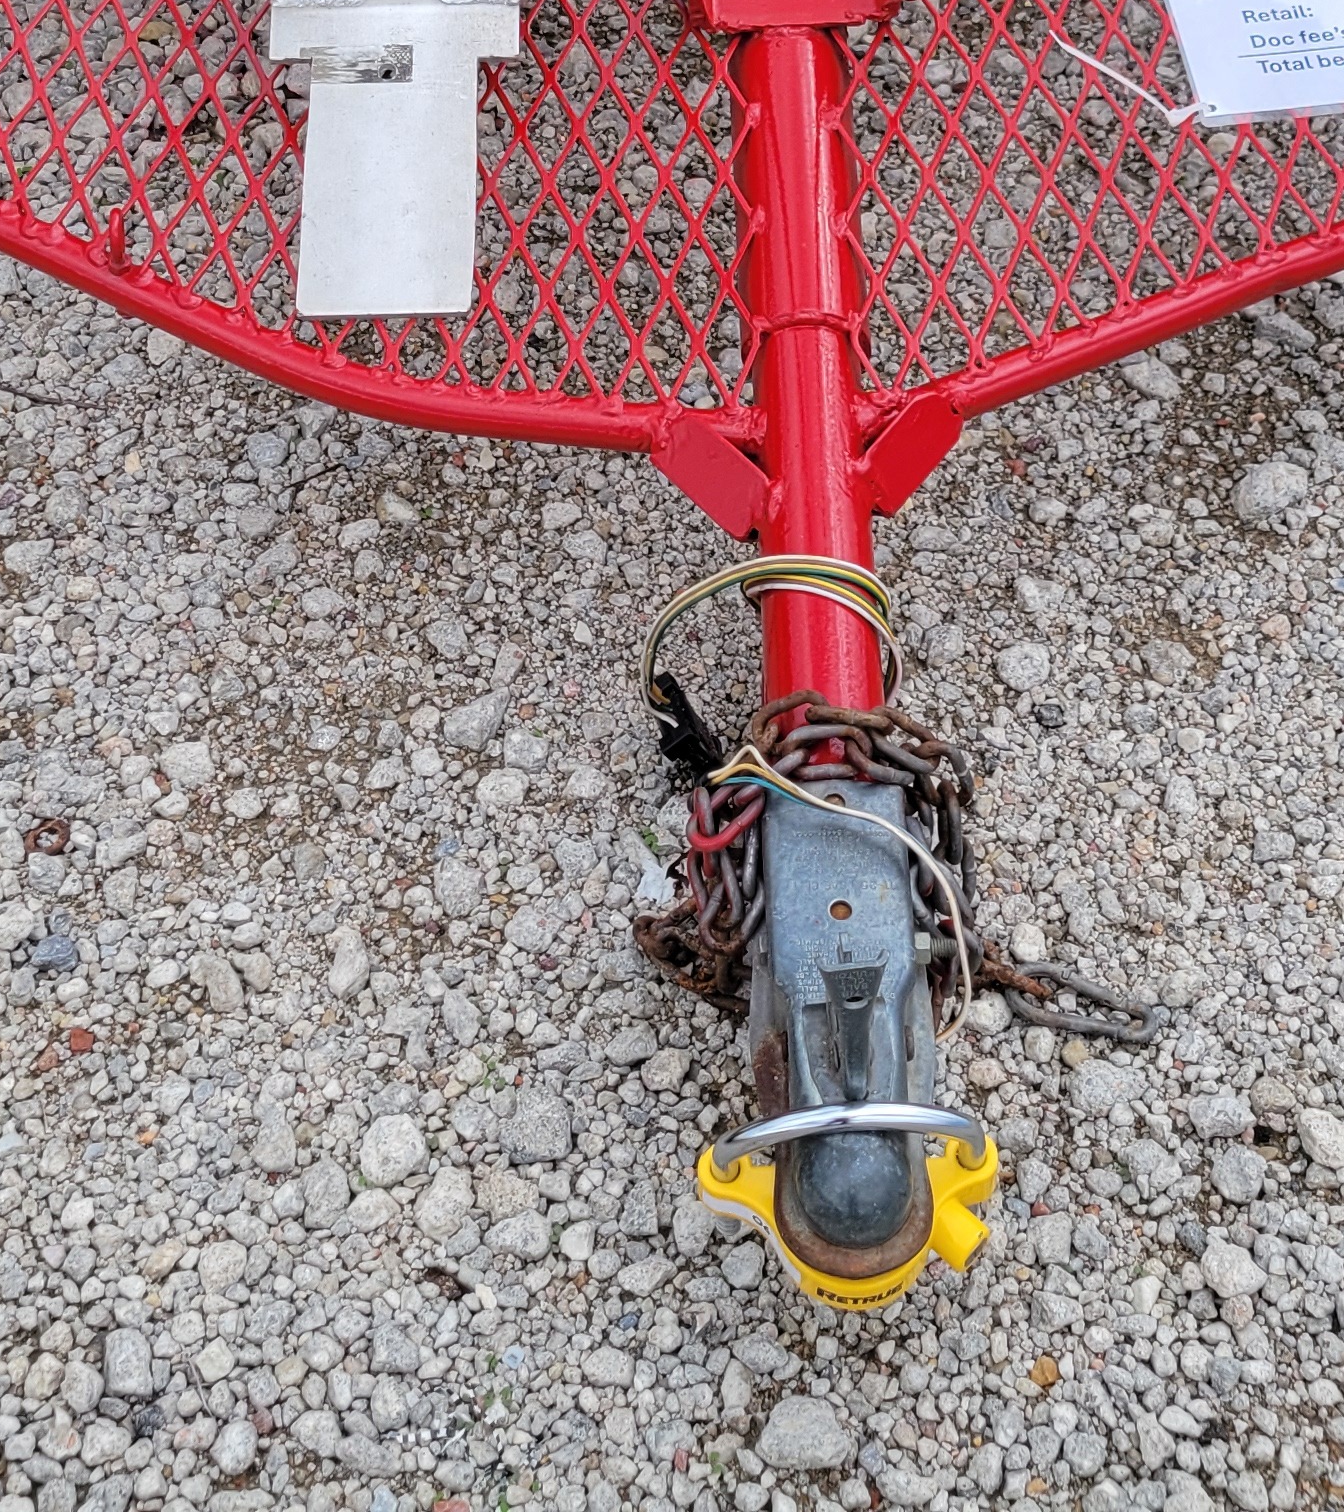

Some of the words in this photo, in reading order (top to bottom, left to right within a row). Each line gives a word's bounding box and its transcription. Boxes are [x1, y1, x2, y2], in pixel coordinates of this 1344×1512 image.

[1241, 4, 1314, 24] Retail:
[1249, 34, 1295, 49] Doc
[1256, 55, 1314, 75] Total
